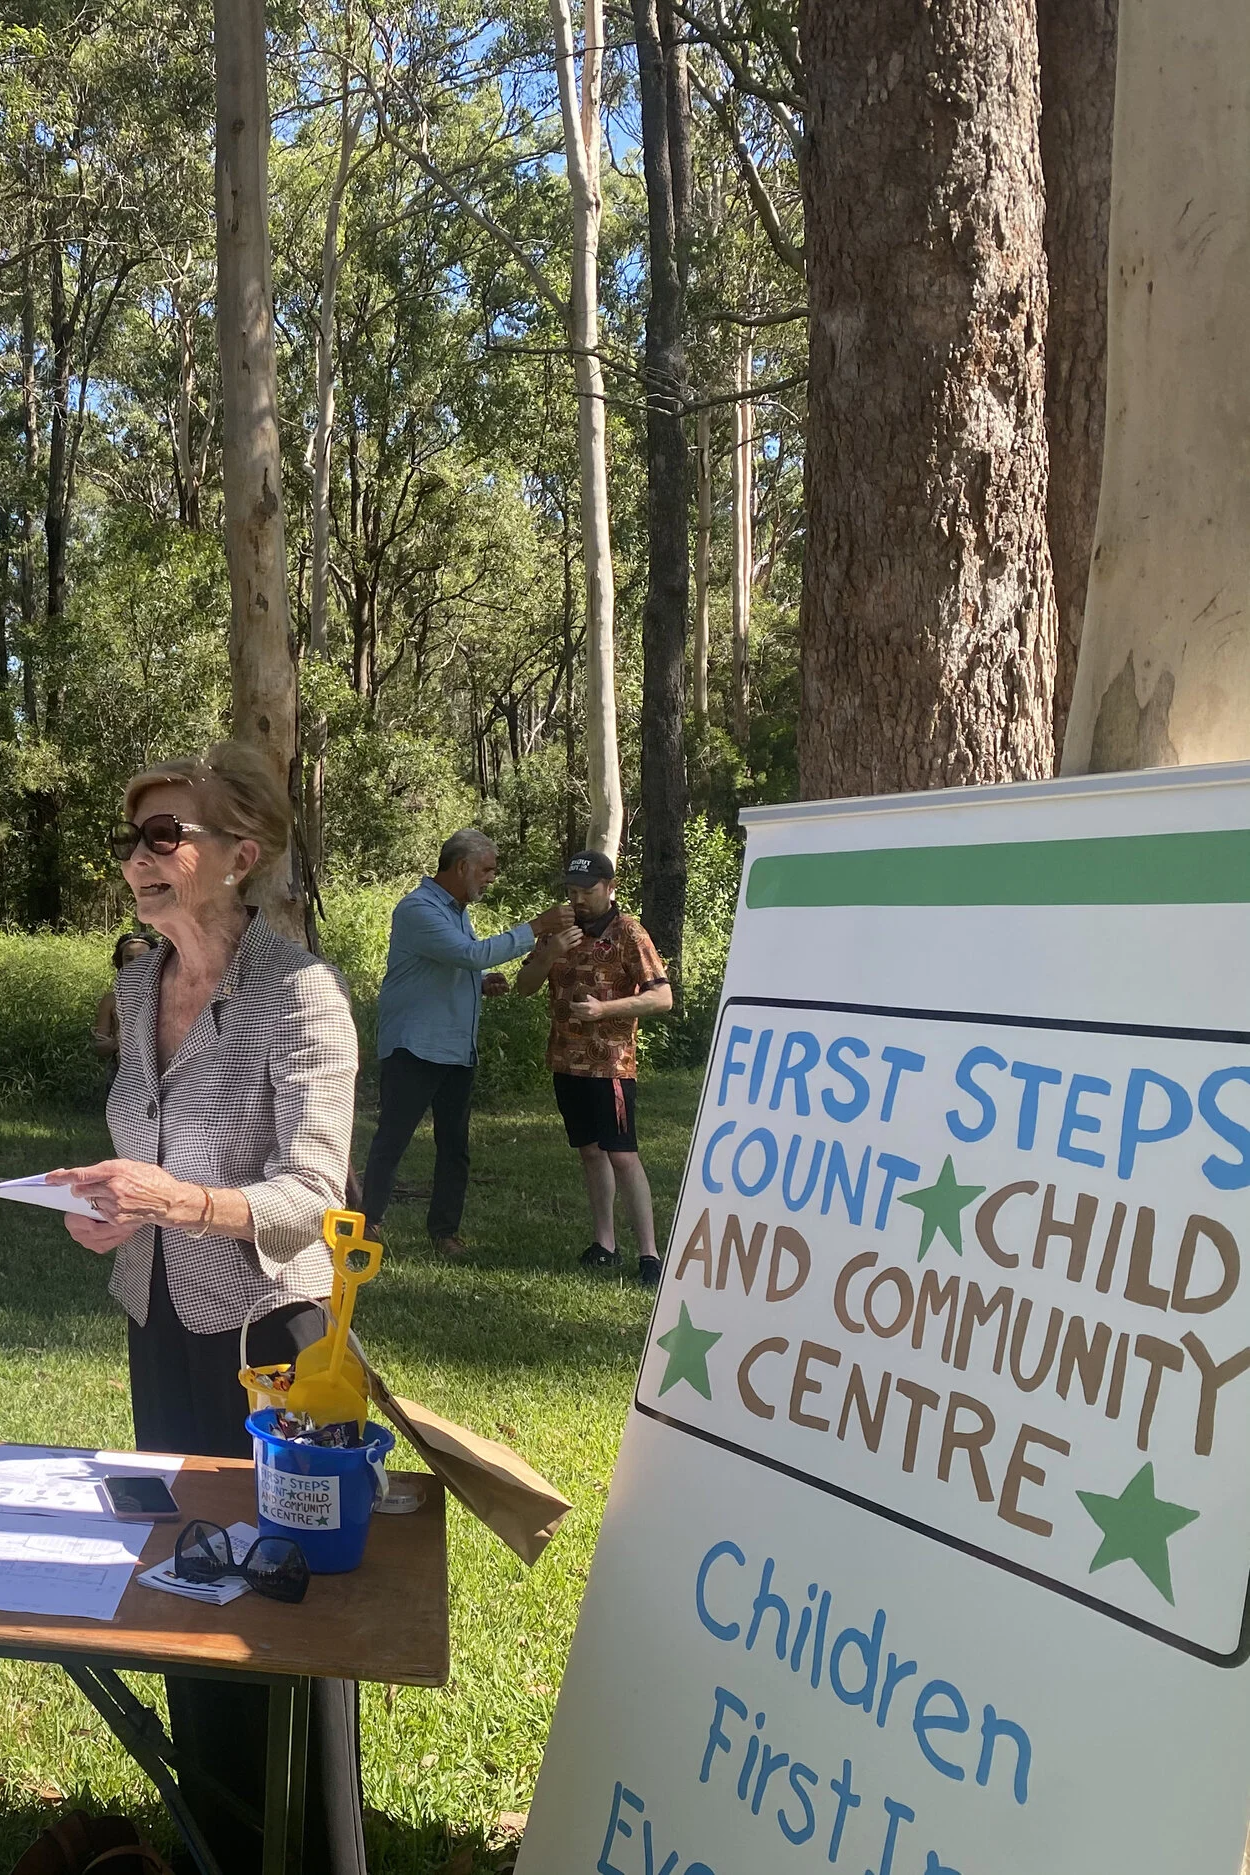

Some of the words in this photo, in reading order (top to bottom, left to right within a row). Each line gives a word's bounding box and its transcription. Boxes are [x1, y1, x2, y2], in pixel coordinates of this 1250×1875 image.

[718, 1025, 925, 1123] FIRST
[946, 1046, 1250, 1190] STEPS
[702, 1121, 920, 1231] COUNT
[975, 1181, 1240, 1314] CHILD
[675, 1208, 811, 1302] AND
[834, 1251, 1250, 1456] COMMUNITY
[261, 1469, 285, 1485] FIRST
[290, 1478, 330, 1491] STEPS
[261, 1480, 287, 1497] COUNT
[296, 1492, 329, 1503] CHILD
[261, 1491, 276, 1503] AND
[280, 1498, 332, 1514] COMMUNITY
[270, 1507, 313, 1526] CENTRE
[737, 1337, 1070, 1537] CENTRE
[696, 1541, 1031, 1804] Children
[699, 1686, 861, 1862] First
